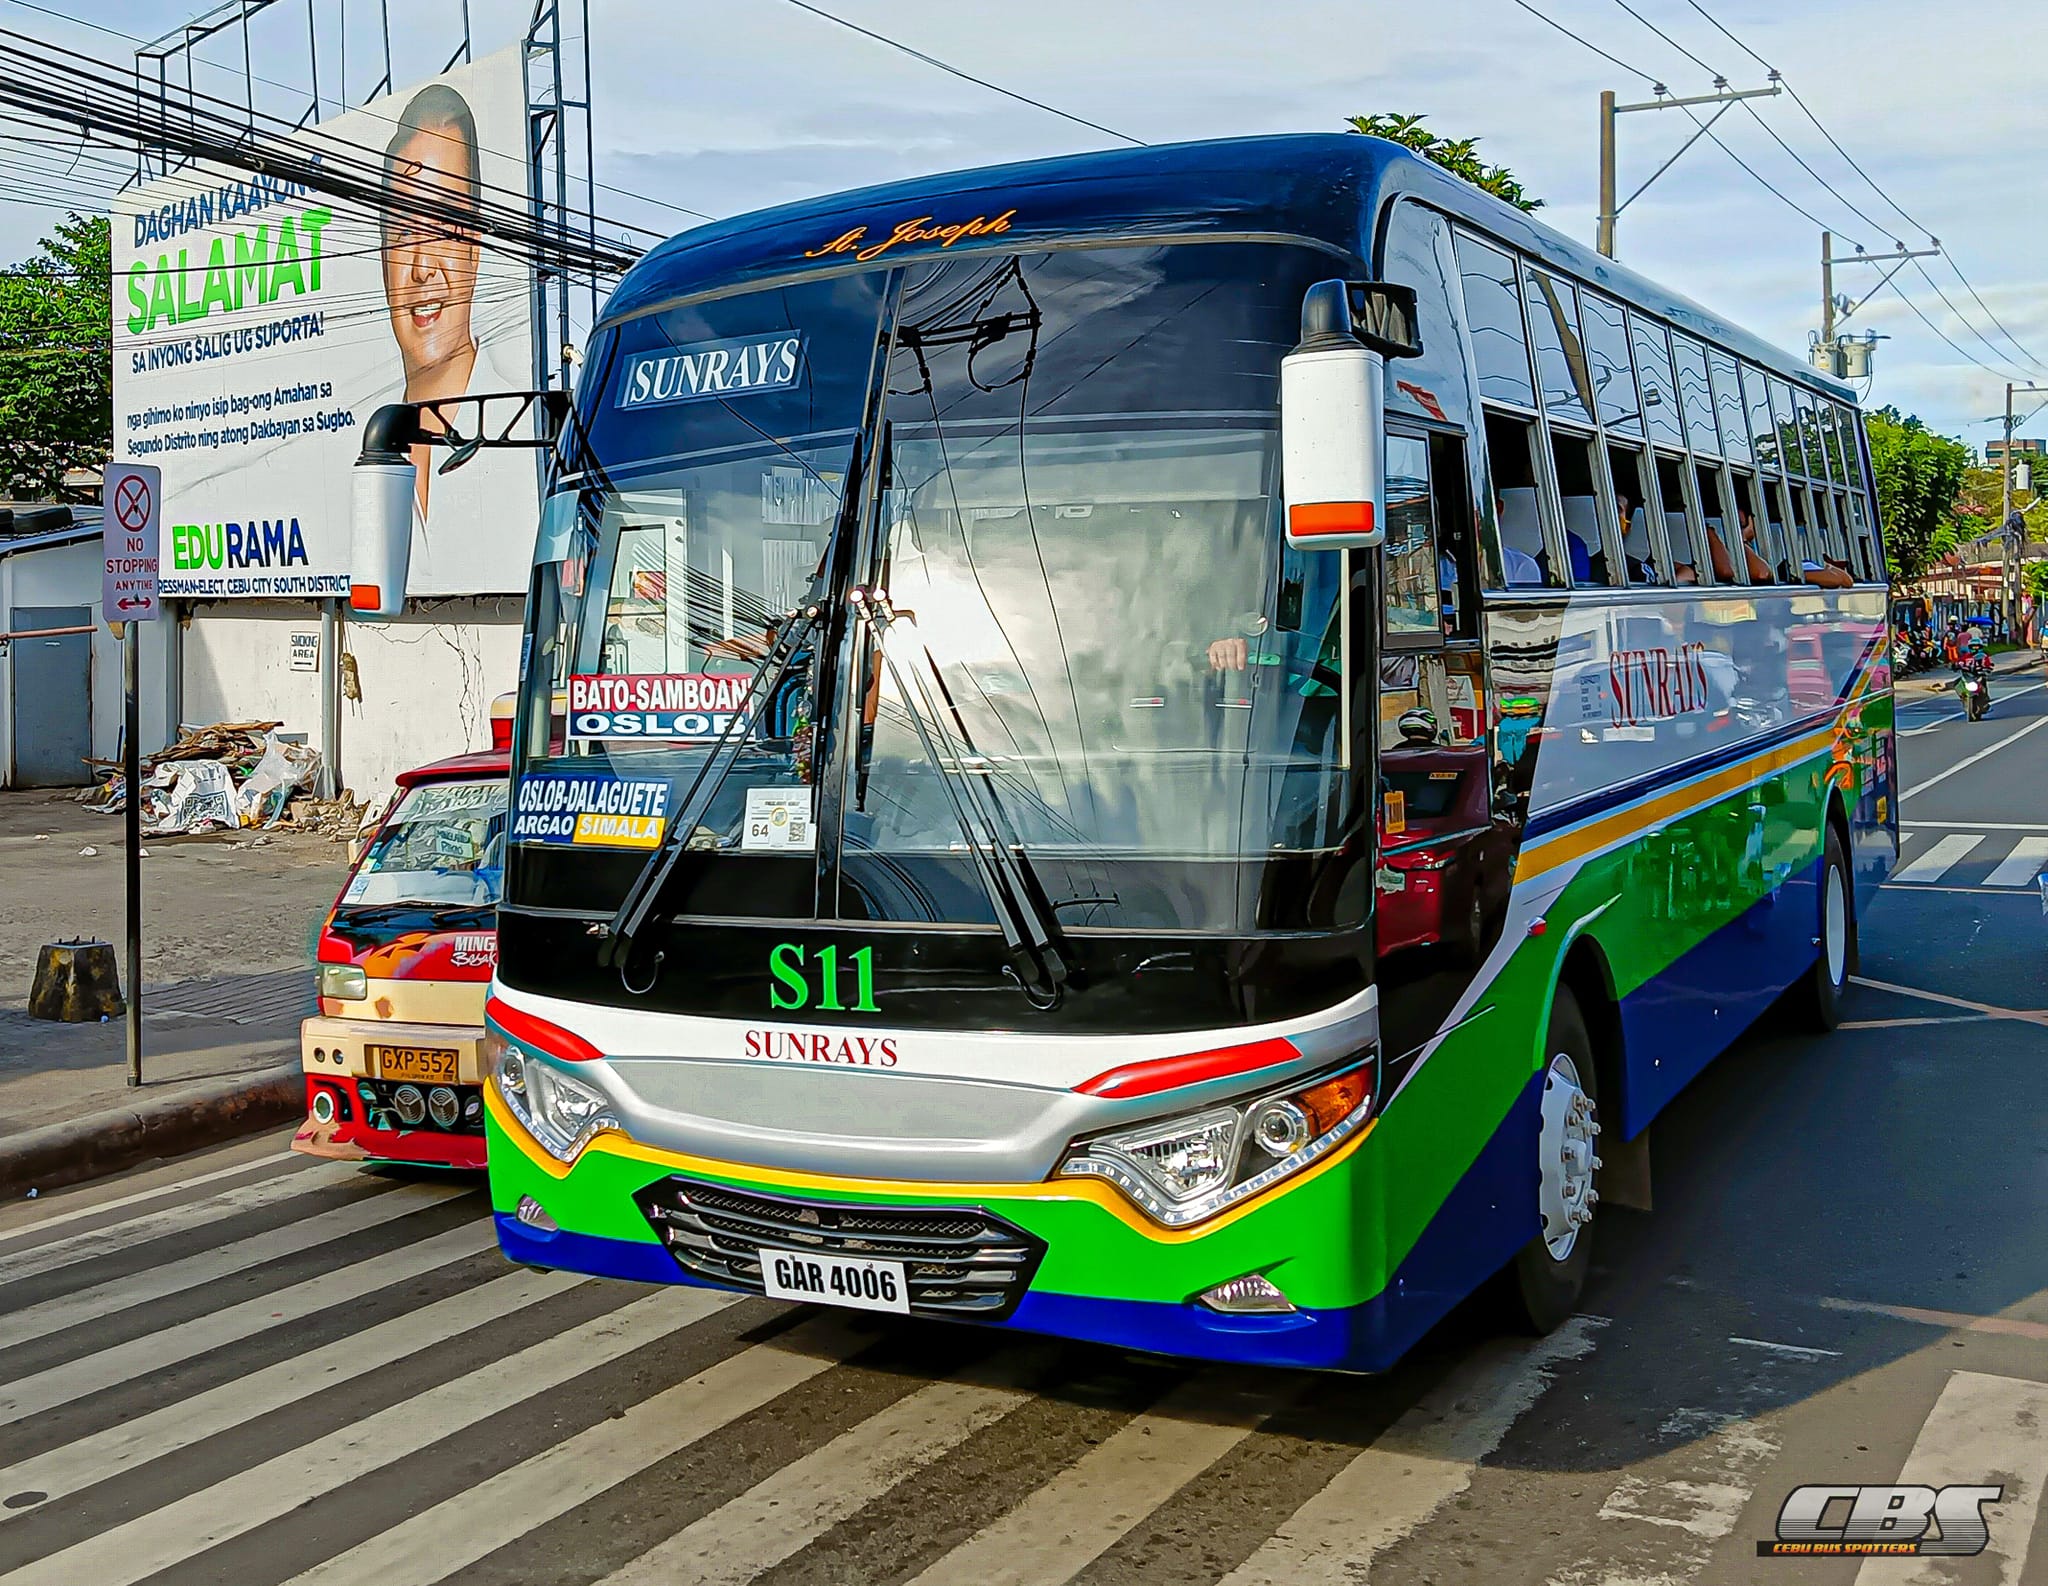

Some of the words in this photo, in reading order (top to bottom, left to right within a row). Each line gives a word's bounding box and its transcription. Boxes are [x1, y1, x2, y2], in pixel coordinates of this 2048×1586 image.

[135, 191, 213, 248] DAGHAN
[805, 226, 858, 257] St.
[857, 209, 1017, 261] Joseph
[127, 207, 332, 335] SALAMAT
[132, 352, 147, 373] SA
[149, 341, 192, 371] INYONG
[195, 333, 231, 361] SALIG
[235, 329, 252, 353] UG
[255, 311, 324, 349] SUPORTA!
[630, 337, 800, 403] SUNRAYS
[127, 414, 142, 431] nga
[143, 405, 171, 426] gihimo
[173, 404, 184, 422] ko
[185, 400, 211, 421] ninyo
[213, 396, 228, 417] isip
[231, 391, 272, 415] bag-ong
[274, 382, 318, 405] Amahan
[320, 382, 332, 398] sa
[127, 437, 163, 457] Segundo
[165, 430, 196, 451] Distrito
[198, 429, 219, 449] ning
[220, 426, 249, 445] atong
[250, 417, 301, 440] Dakbayan
[302, 417, 314, 432] sa
[127, 538, 144, 552] NO
[106, 558, 158, 574] STOPPING
[227, 577, 250, 594] CEBU
[252, 577, 273, 594] CITY
[274, 576, 305, 593] SOUTH
[307, 575, 351, 592] DISTRICT
[115, 580, 153, 591] ANYTIME
[293, 649, 314, 658] AREA
[575, 713, 747, 735] OSLOB
[518, 780, 668, 817] OSLOB-DALAGUETE
[513, 815, 575, 836] ARGAO
[578, 817, 658, 839] SIMALA
[752, 824, 769, 837] 64
[769, 943, 882, 1012] S11
[383, 1048, 415, 1070] GXP
[420, 1053, 454, 1074] 552
[744, 1029, 899, 1068] SUNRAYS
[774, 1258, 825, 1294] GAR
[830, 1265, 898, 1303] 4006
